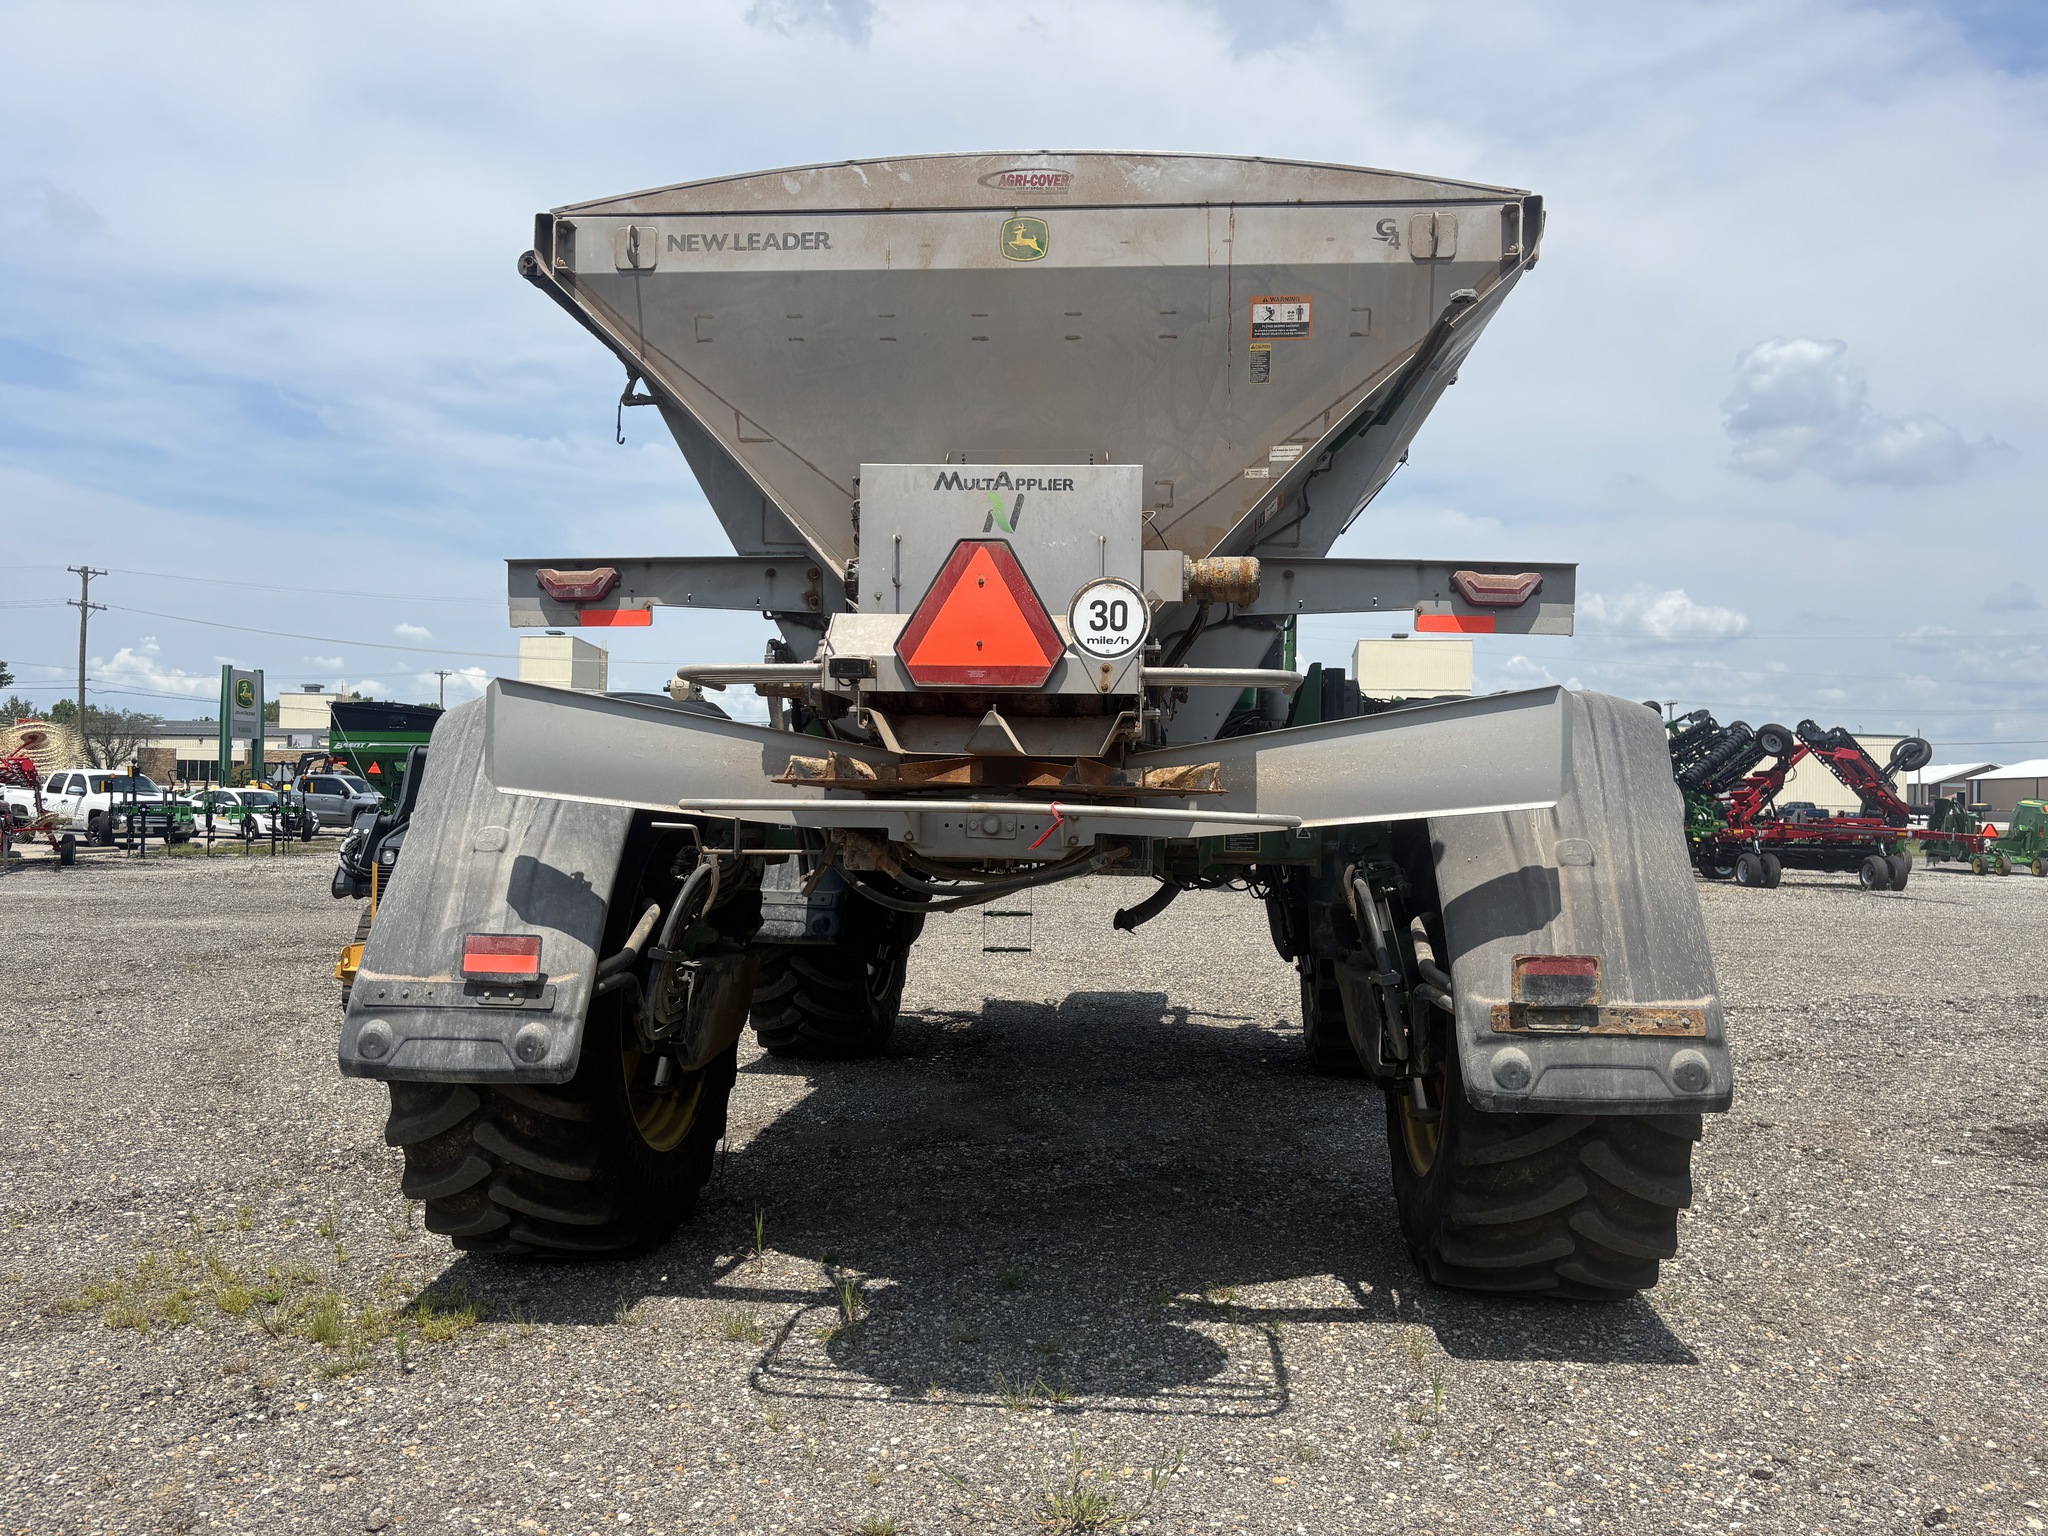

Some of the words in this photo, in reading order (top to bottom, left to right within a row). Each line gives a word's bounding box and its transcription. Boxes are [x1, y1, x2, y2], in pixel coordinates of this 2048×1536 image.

[998, 174, 1070, 187] AGRI-COVER
[667, 233, 729, 252] NEW
[733, 231, 831, 251] LEADER
[1089, 599, 1128, 632] 30
[1086, 635, 1130, 645] mile/h
